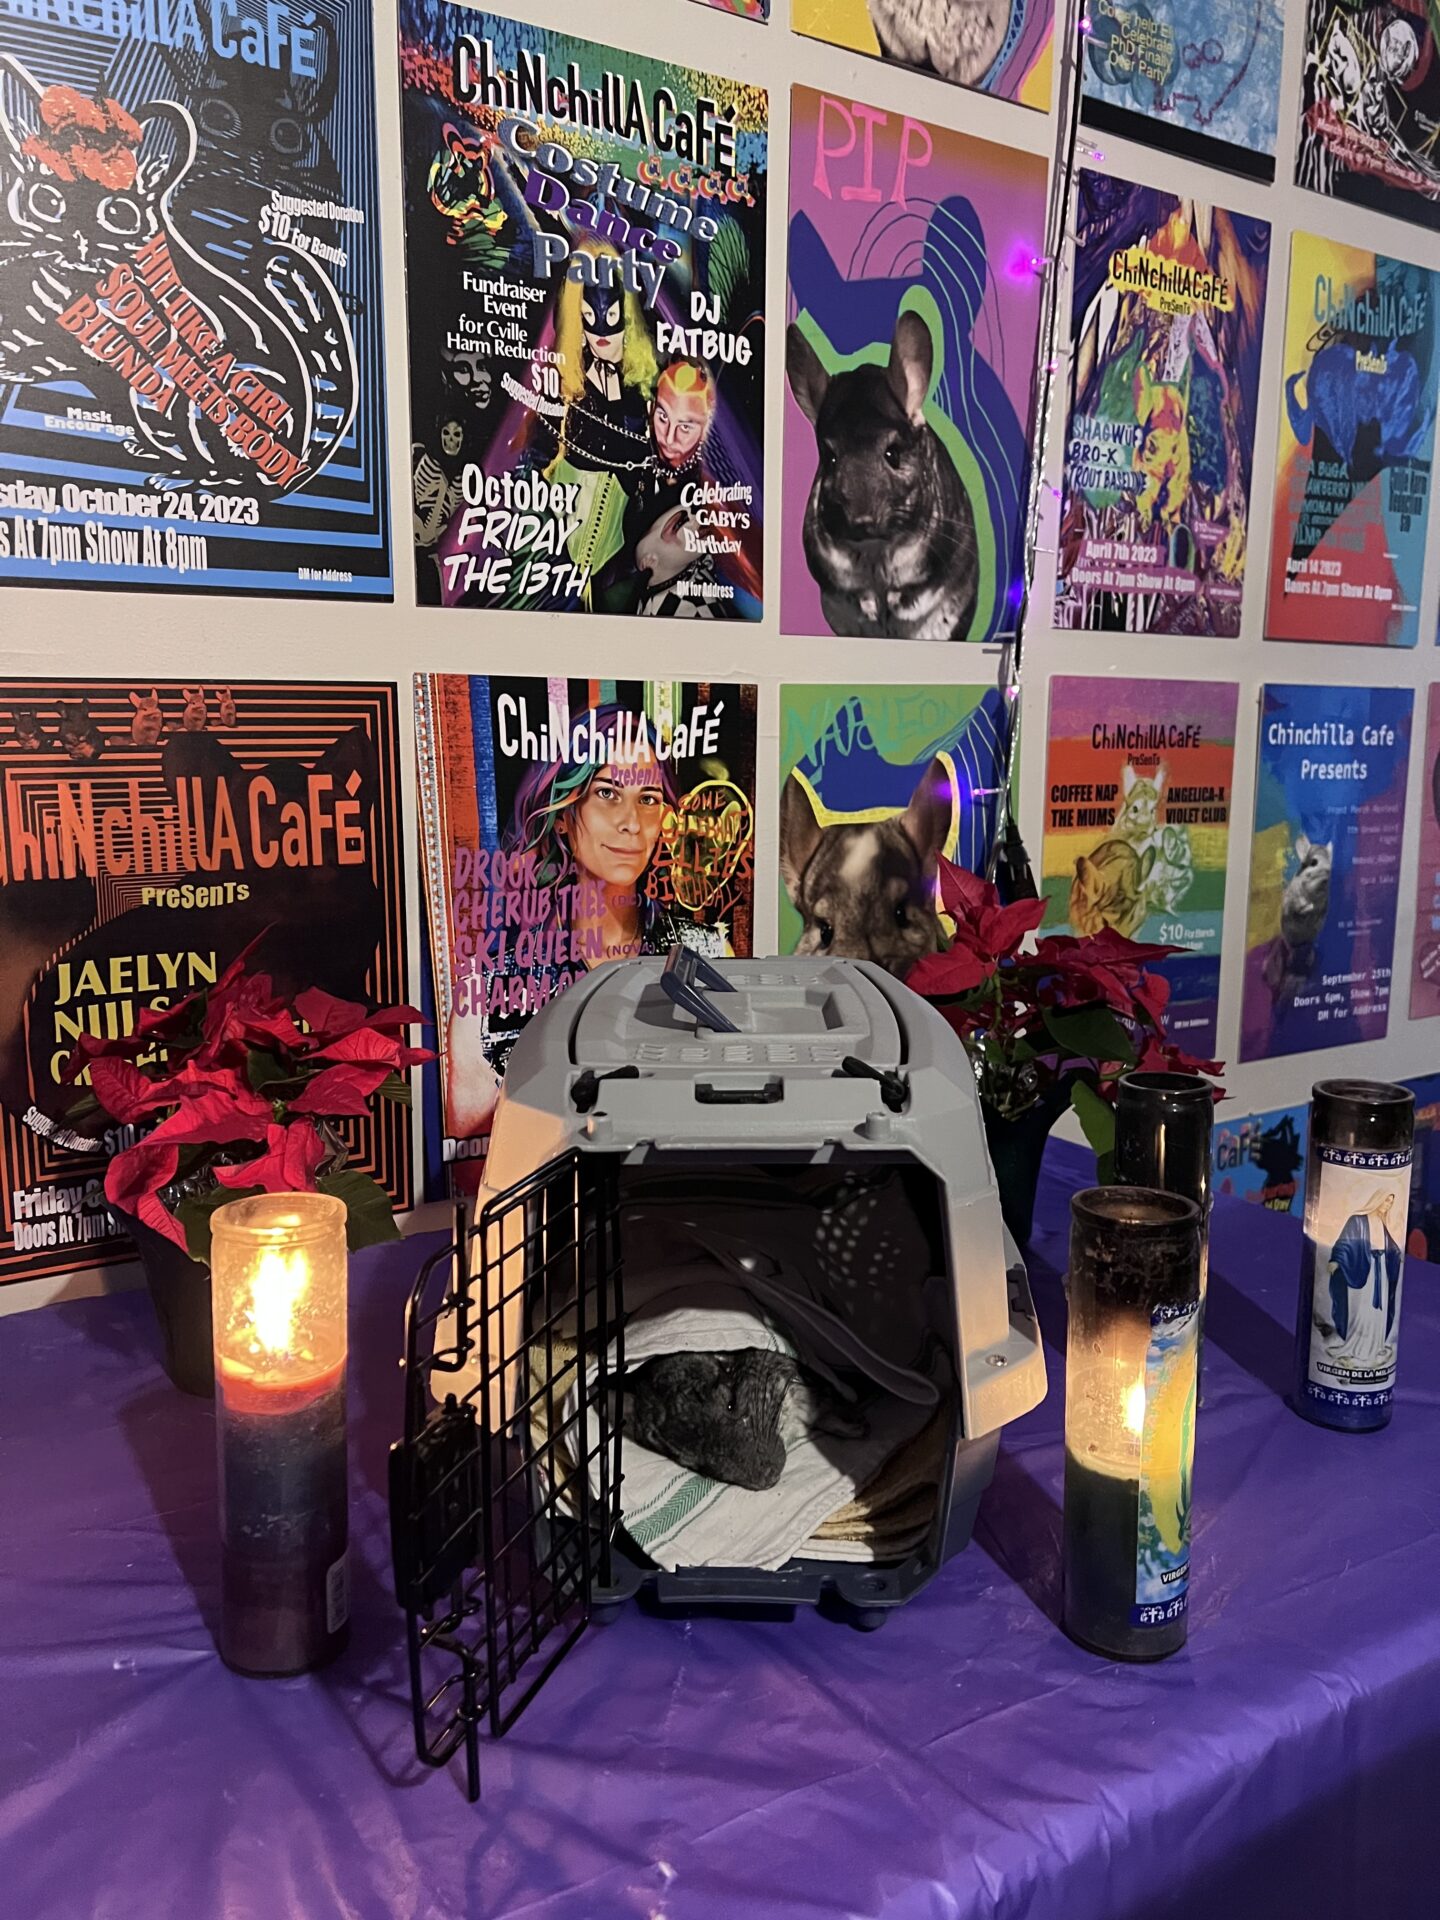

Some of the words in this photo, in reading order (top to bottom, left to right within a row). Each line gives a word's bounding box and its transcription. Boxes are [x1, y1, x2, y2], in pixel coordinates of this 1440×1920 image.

[1121, 23, 1173, 52] Celebrate
[1135, 11, 1157, 34] help
[1111, 34, 1135, 55] PhD
[1138, 60, 1168, 86] Party
[653, 86, 739, 178] CaFÉ
[813, 95, 933, 211] PIP
[498, 117, 719, 243] Costume
[271, 190, 328, 216] Suggested
[328, 202, 364, 224] Donation
[525, 168, 682, 264] Dance
[259, 205, 288, 241] $10
[291, 228, 310, 247] For
[311, 237, 347, 267] Bands
[533, 231, 667, 308] Party
[1112, 251, 1191, 298] ChiNchillA
[1192, 273, 1229, 305] CaFÉ
[462, 271, 546, 304] Fundraiser
[483, 294, 527, 320] Event
[690, 291, 721, 325] DJ
[164, 292, 224, 361] LIKE
[458, 314, 484, 335] for
[487, 319, 528, 343] Cville
[656, 321, 753, 366] FATBUG
[56, 293, 175, 414] BLUNDA
[446, 332, 490, 354] Harm
[494, 340, 566, 365] Reduction
[96, 263, 166, 353] SOUL
[154, 342, 235, 424] MEETS
[227, 413, 311, 488] BODY
[531, 362, 559, 399] $10
[66, 407, 112, 423] Mask
[63, 483, 161, 517] October
[163, 494, 199, 523] 24,
[200, 496, 259, 525] 2023
[461, 463, 581, 514] October
[680, 481, 753, 508] Celebrating
[458, 507, 582, 556] FRIDAY
[695, 509, 750, 530] GABY'S
[15, 515, 37, 560] At
[38, 516, 81, 565] 7pm
[85, 521, 138, 565] Show
[142, 526, 162, 567] At
[165, 530, 208, 573] 8pm
[684, 527, 741, 556] Birthday
[1085, 540, 1112, 559] April
[1113, 543, 1130, 561] 7th
[1131, 545, 1157, 563] 2023
[298, 567, 310, 580] DM
[311, 568, 321, 581] for
[322, 569, 352, 583] Address
[444, 553, 512, 596] THE
[519, 559, 591, 598] 13TH
[1072, 567, 1101, 584] Doors
[1286, 557, 1307, 573] April
[702, 583, 734, 600] Address
[497, 693, 650, 764] ChiNchillA
[1092, 723, 1166, 750] ChiNchillA
[1168, 724, 1202, 749] CaFÉ
[1268, 722, 1354, 746] Chinchilla
[1362, 724, 1395, 746] Cafe
[1301, 759, 1368, 780] Presents
[1051, 785, 1093, 802] COFFEE
[1095, 784, 1119, 801] NAP
[0, 776, 244, 885] hiNchillA
[248, 769, 365, 868] CaFÉ
[1051, 809, 1073, 827] THE
[1076, 808, 1116, 826] MUMS
[1166, 808, 1199, 824] VIOLET
[1201, 807, 1227, 822] CLUB
[453, 848, 538, 890] DROOK
[453, 889, 551, 931] CHERUB
[558, 880, 608, 922] TREE
[1160, 922, 1184, 944] $10
[453, 930, 507, 977] SKI
[515, 926, 604, 969] QUEEN
[54, 951, 218, 1005] JAELYN
[453, 974, 552, 1018] CHARM
[1293, 995, 1320, 1007] Doors
[442, 1136, 490, 1162] Door
[13, 1185, 83, 1219] Friday
[12, 1221, 57, 1250] Doors
[59, 1215, 74, 1243] At
[75, 1212, 106, 1243] 7pm
